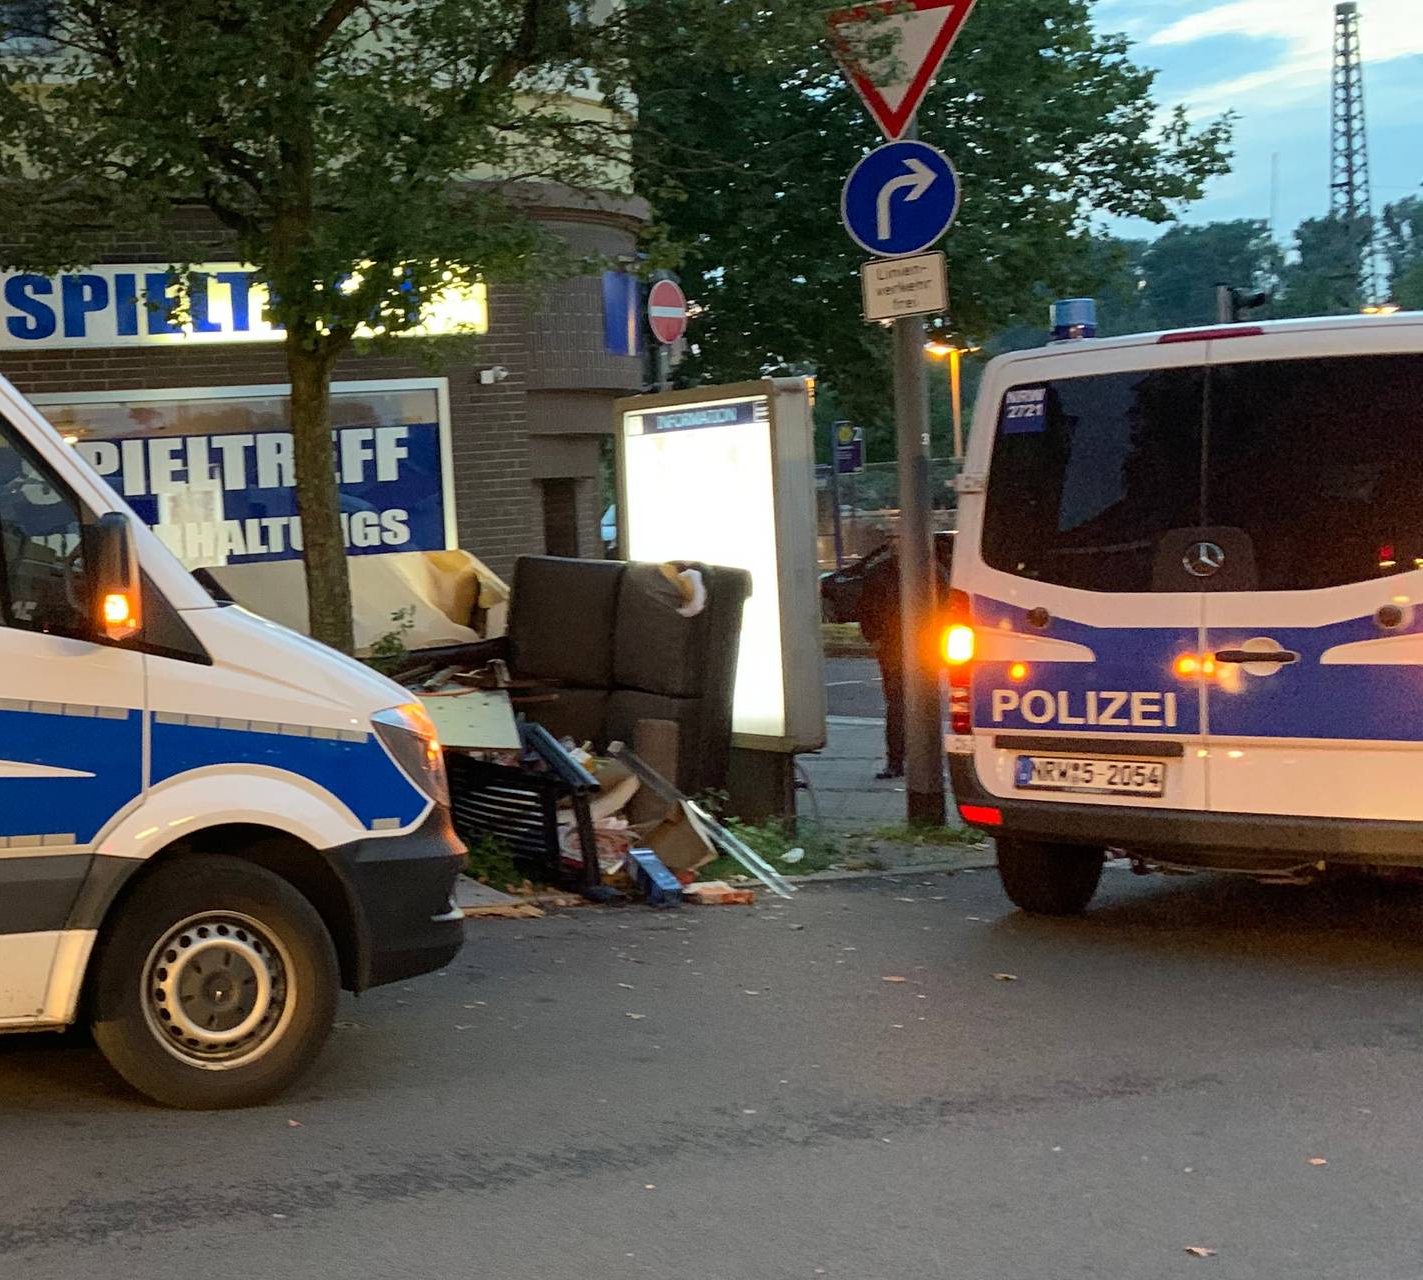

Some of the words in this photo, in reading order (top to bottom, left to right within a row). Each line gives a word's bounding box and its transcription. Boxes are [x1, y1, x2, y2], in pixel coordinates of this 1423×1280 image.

[876, 279, 932, 296] verkehr
[1006, 404, 1044, 419] 2721
[992, 689, 1177, 727] POLIZEI
